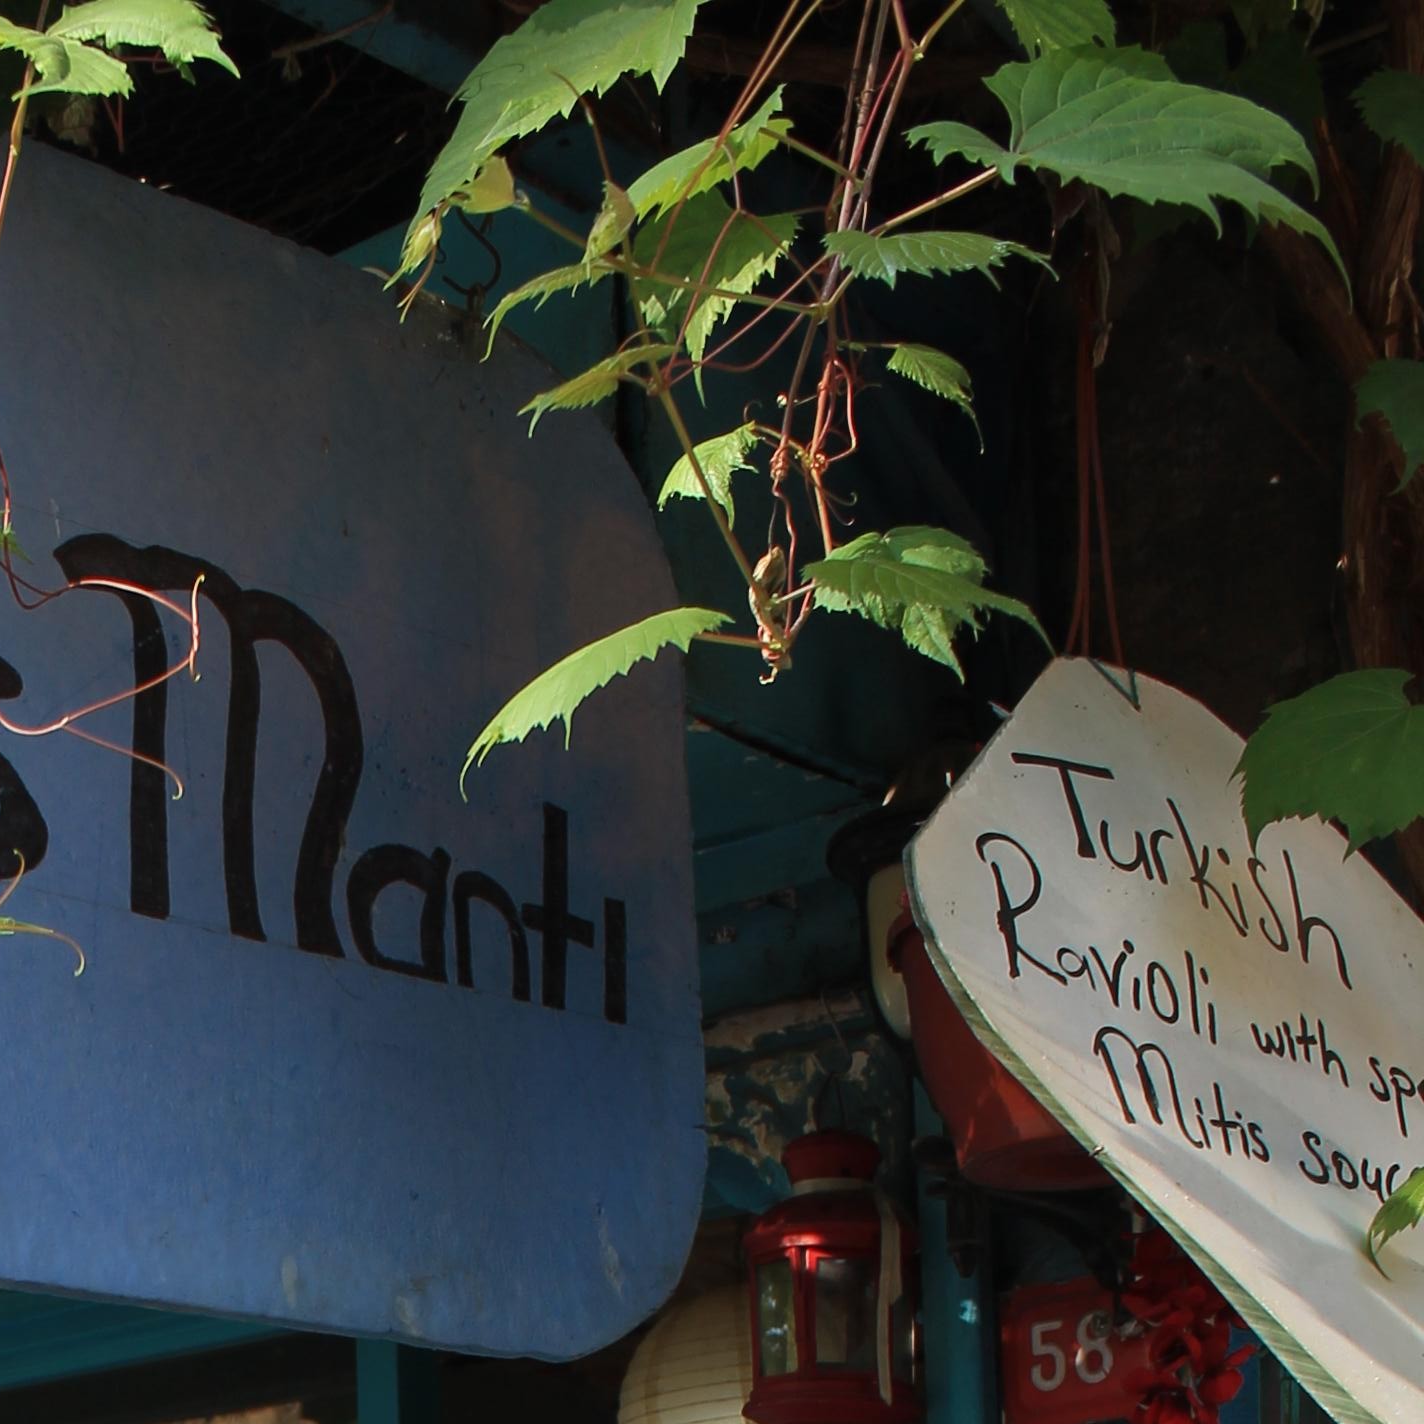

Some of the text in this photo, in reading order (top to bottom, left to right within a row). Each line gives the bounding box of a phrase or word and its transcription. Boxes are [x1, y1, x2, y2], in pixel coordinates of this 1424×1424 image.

[1012, 752, 1352, 990] Turkish
[976, 832, 1424, 1138] Ravioli with sp
[1093, 1025, 1271, 1165] Mitis
[1030, 1310, 1114, 1392] 58
